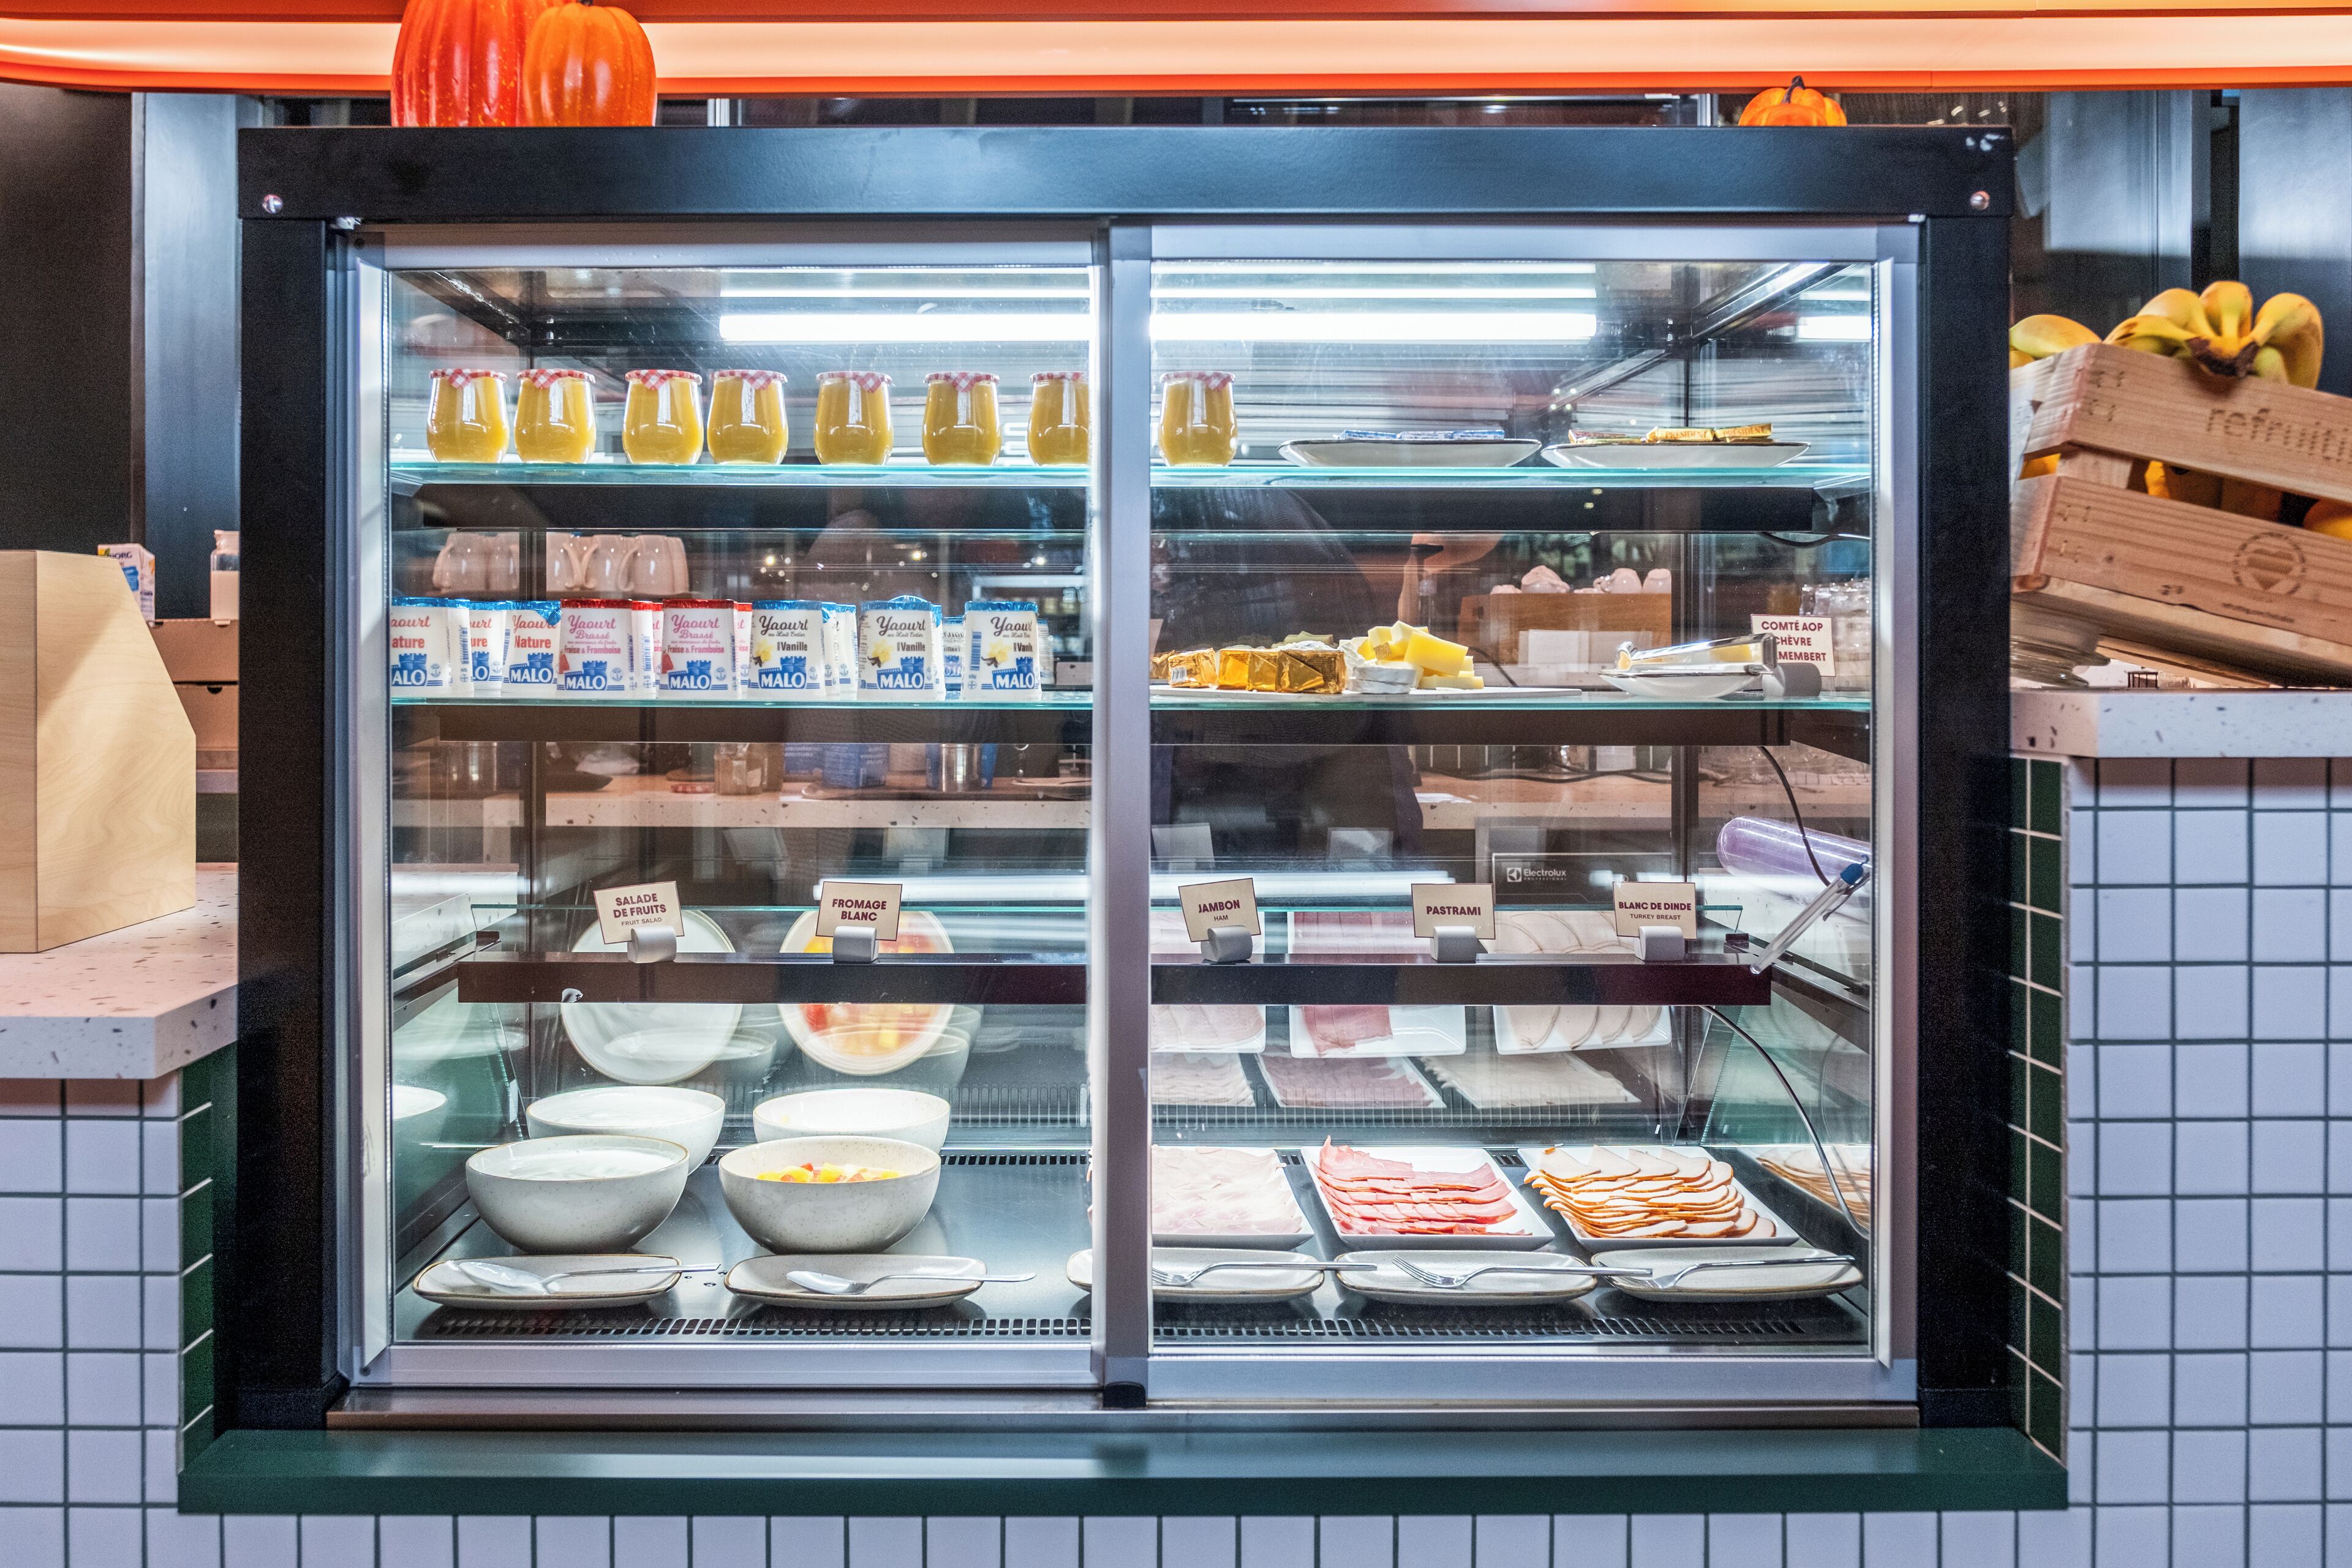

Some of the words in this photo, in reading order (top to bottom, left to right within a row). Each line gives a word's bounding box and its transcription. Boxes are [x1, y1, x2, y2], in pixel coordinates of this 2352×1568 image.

[391, 616, 431, 627] aourt
[568, 614, 616, 634] Yaourt
[671, 614, 720, 633] Yaourt
[759, 616, 809, 635] Yaourt
[876, 616, 926, 636] Yaourt
[1762, 620, 1799, 631] COMTÉ
[1802, 622, 1823, 631] AOP
[575, 630, 610, 639] Brassé
[679, 630, 714, 639] Brassé
[391, 636, 424, 649] ature
[514, 636, 551, 649] Nature
[781, 641, 808, 651] Vanille
[901, 642, 925, 652] Vanille
[564, 645, 580, 654] Fraise
[587, 646, 621, 654] Framboise
[691, 645, 725, 654] Framboise
[1777, 651, 1826, 662] MEMBERT
[392, 669, 426, 685] ALO
[511, 668, 551, 683] MALO
[670, 674, 710, 690] MALO
[761, 673, 805, 688] MALO
[880, 673, 924, 688] MALO
[997, 673, 1035, 688] MALO
[566, 675, 606, 690] MALO
[615, 893, 658, 907] SALADE
[832, 898, 887, 910] FROMAGE
[1198, 899, 1241, 914] JAMBON
[1618, 901, 1648, 910] BLANC
[1664, 902, 1692, 911] DINDE
[613, 908, 628, 918] DE
[630, 903, 667, 916] FRUITS
[841, 911, 878, 922] BLANC
[1426, 905, 1482, 916] PASTRAMI
